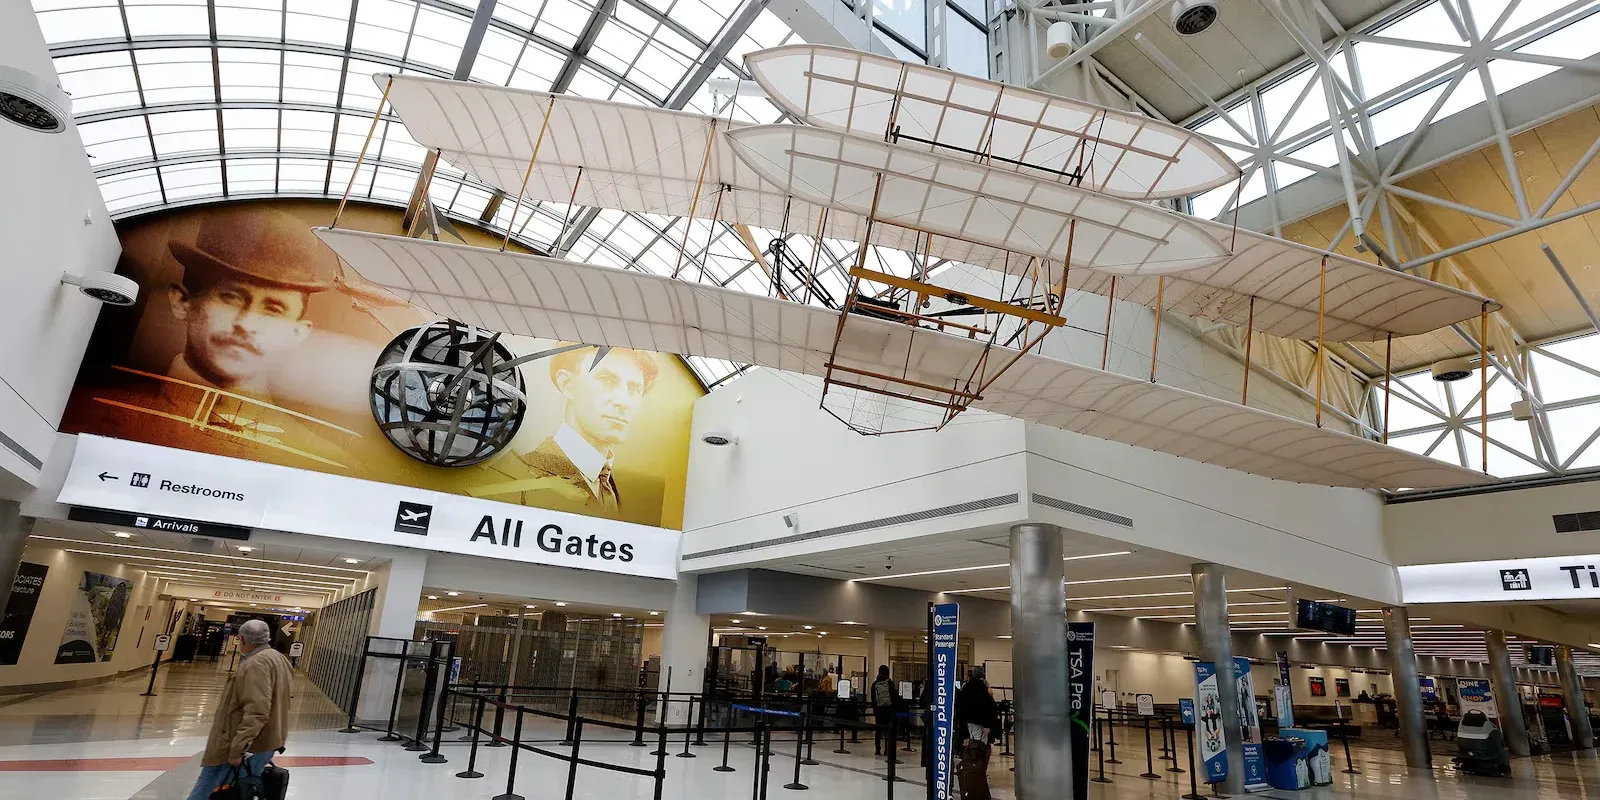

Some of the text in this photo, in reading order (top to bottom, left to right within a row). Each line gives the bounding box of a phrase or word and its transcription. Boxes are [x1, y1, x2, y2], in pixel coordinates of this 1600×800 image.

[160, 479, 245, 501] Restrooms
[153, 519, 199, 533] Arrivals
[470, 515, 634, 562] All Gates
[1559, 564, 1600, 588] Ti
[937, 653, 947, 722] Standard
[1070, 648, 1084, 710] TSA Pre
[1460, 680, 1480, 688] DINE
